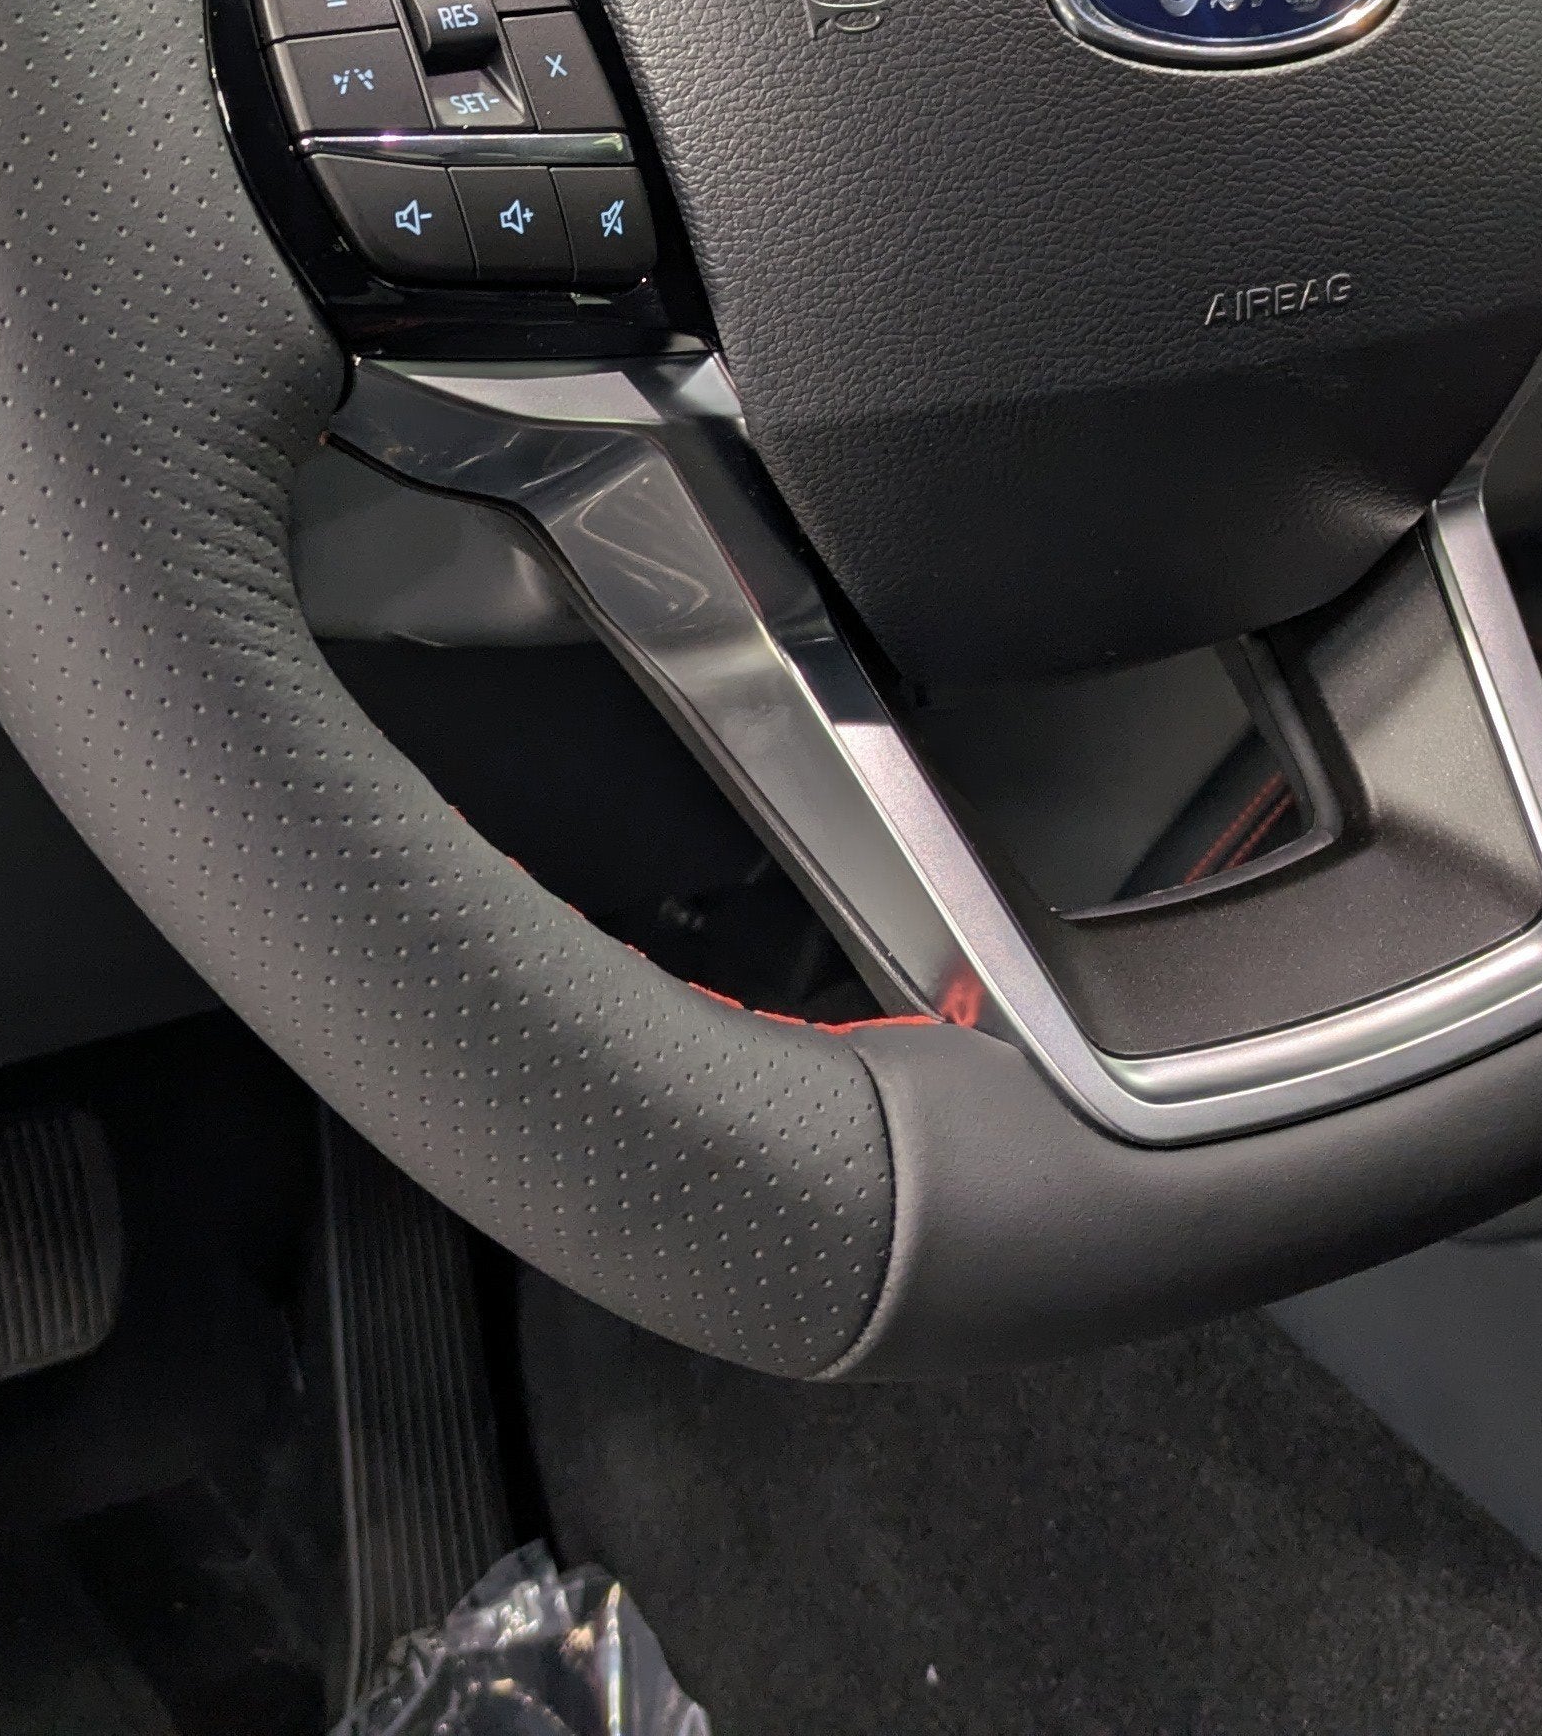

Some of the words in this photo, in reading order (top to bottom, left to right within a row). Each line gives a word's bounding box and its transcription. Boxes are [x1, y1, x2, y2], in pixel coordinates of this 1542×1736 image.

[438, 3, 479, 31] RES
[449, 90, 501, 116] SET-
[1203, 272, 1353, 328] AIRBAG
